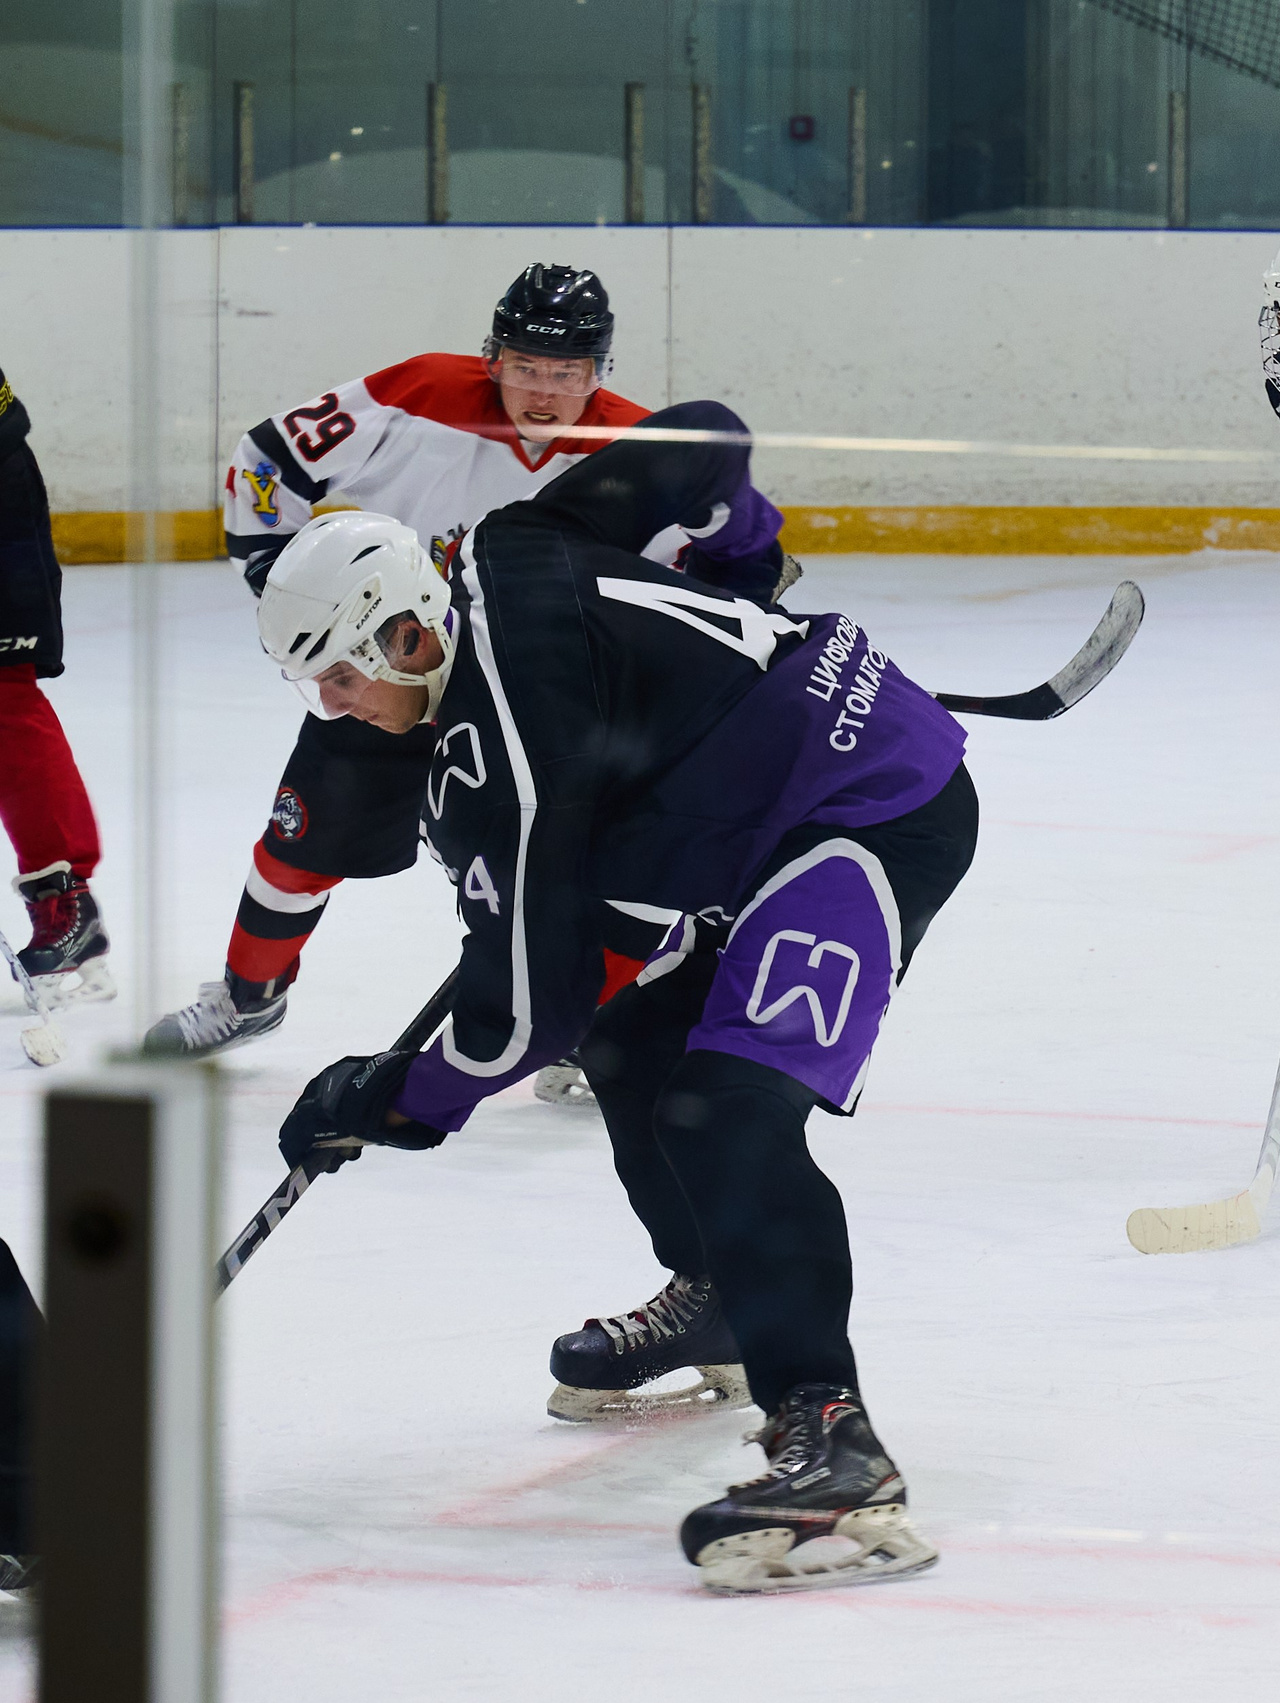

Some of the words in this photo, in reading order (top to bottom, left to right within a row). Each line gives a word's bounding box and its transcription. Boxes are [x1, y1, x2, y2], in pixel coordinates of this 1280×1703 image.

[526, 324, 567, 336] CCM
[283, 392, 356, 463] 29
[355, 596, 382, 630] EASTON
[596, 576, 811, 672] 4
[0, 636, 38, 652] CM
[464, 855, 501, 915] 4
[223, 1164, 312, 1280] CM
